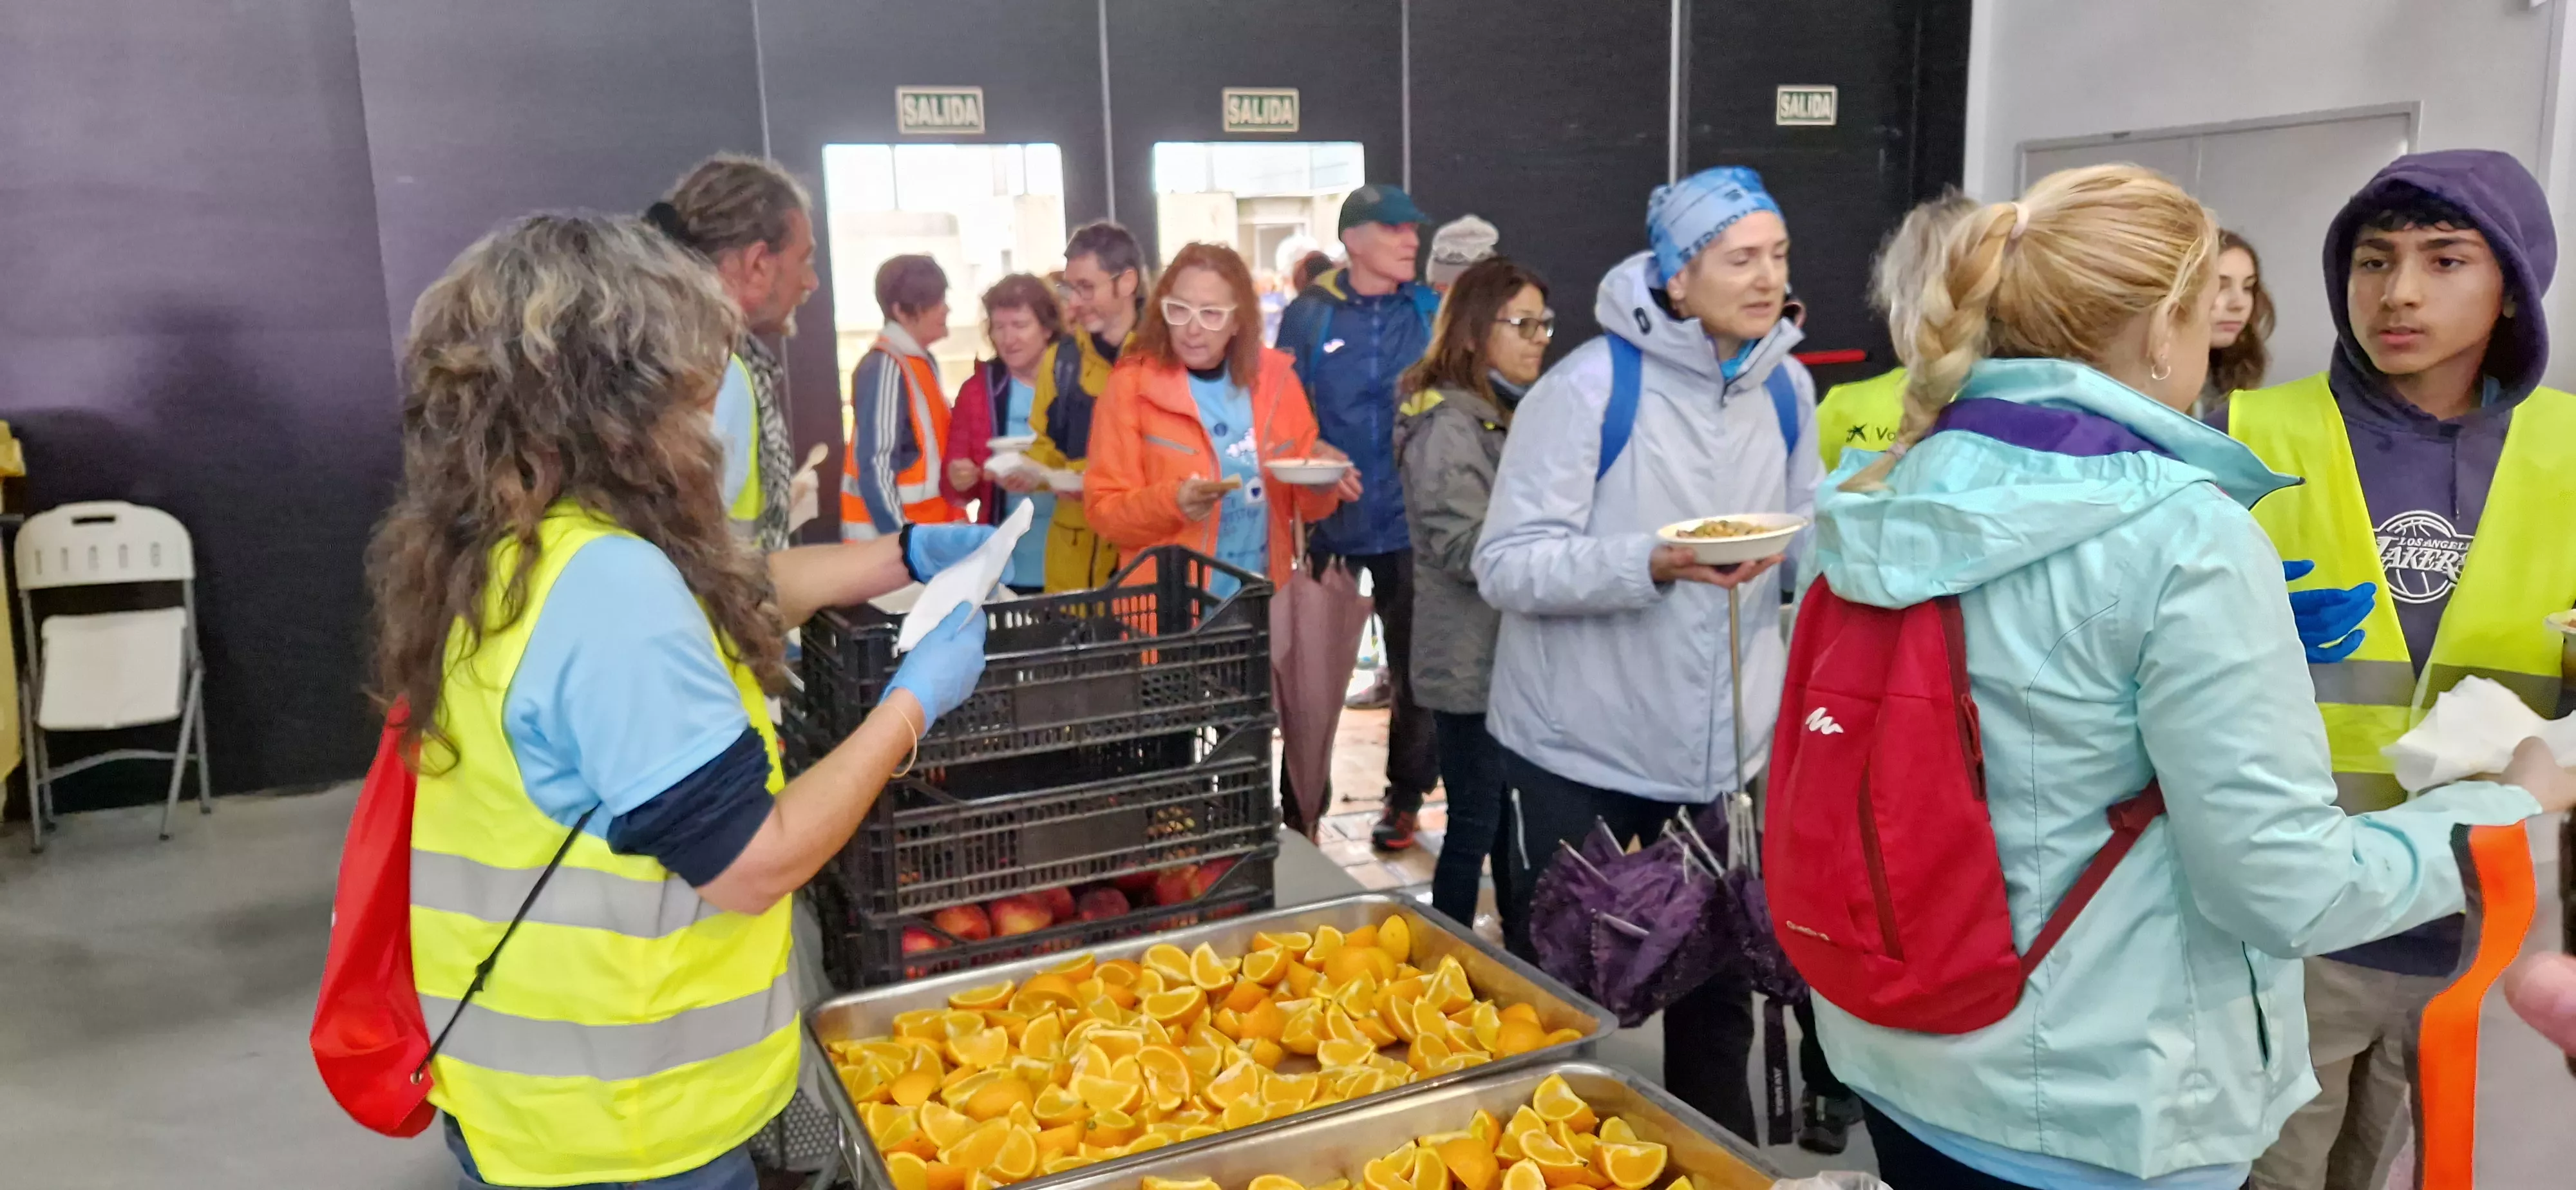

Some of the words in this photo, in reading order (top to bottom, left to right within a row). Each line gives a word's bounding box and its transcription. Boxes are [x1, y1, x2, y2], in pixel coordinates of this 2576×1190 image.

[904, 95, 980, 126] SALIDA
[1228, 96, 1293, 124] SALIDA
[1780, 92, 1832, 118] SALIDA
[1876, 426, 1896, 441] Vo
[2397, 536, 2423, 547] LOS
[2423, 539, 2471, 551] ANGEL
